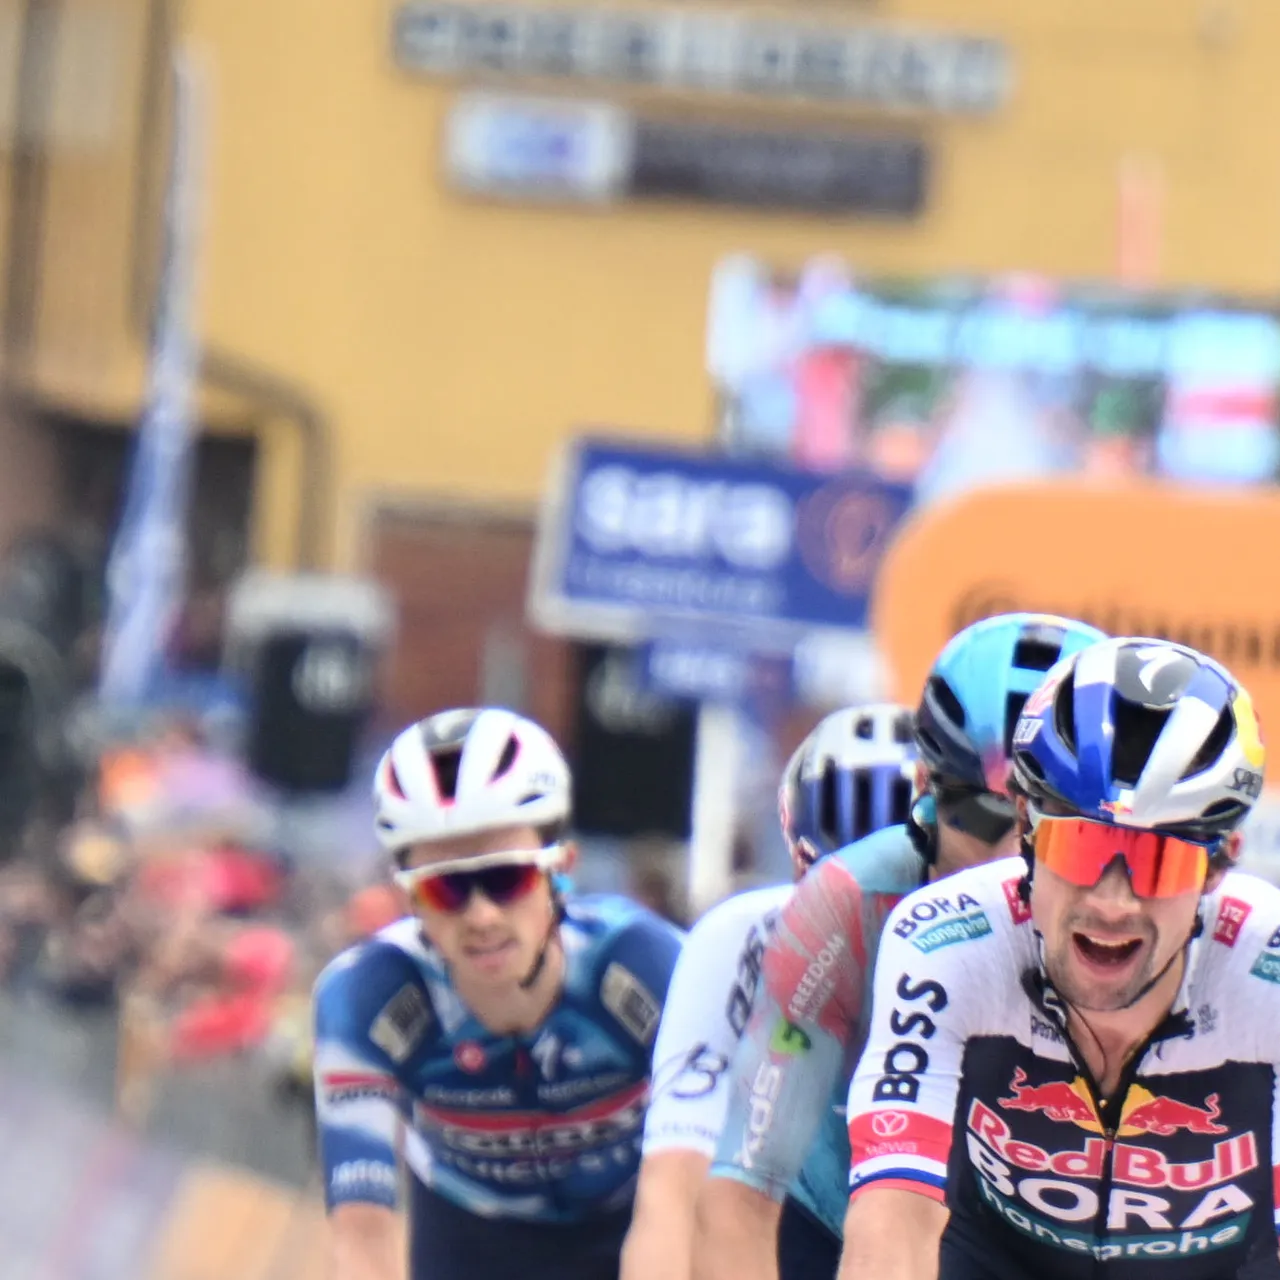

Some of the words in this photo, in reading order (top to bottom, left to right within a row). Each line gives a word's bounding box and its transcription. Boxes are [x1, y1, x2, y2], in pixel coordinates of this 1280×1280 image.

[893, 892, 980, 939] BORA
[787, 933, 846, 1018] FREEDOM
[872, 973, 949, 1103] BOSS
[966, 1098, 1105, 1180] Red
[1111, 1131, 1259, 1192] Bull
[966, 1132, 1255, 1231] BORA
[980, 1174, 1241, 1262] hansgrohe
